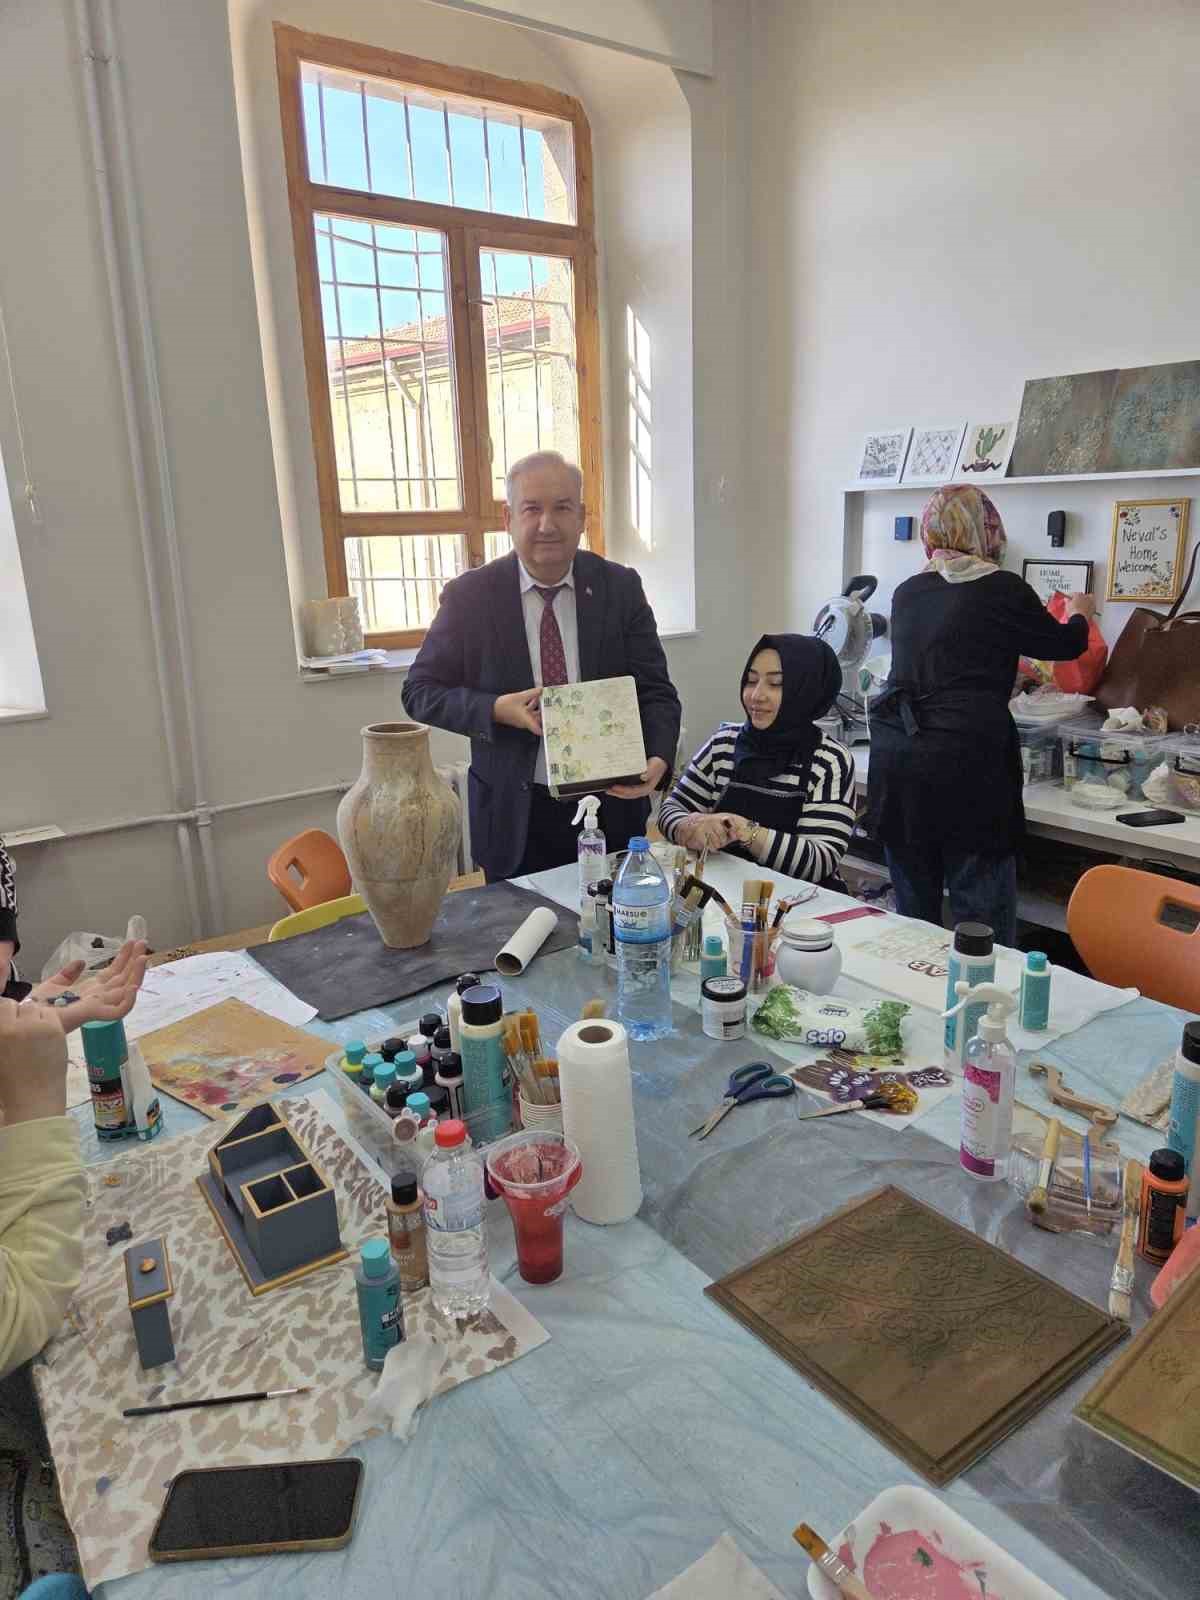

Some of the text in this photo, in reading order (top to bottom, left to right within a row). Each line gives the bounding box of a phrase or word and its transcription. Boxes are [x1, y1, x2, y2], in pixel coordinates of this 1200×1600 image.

[1130, 545, 1159, 561] Home
[1118, 560, 1158, 573] Welcome
[806, 1028, 846, 1047] Solo
